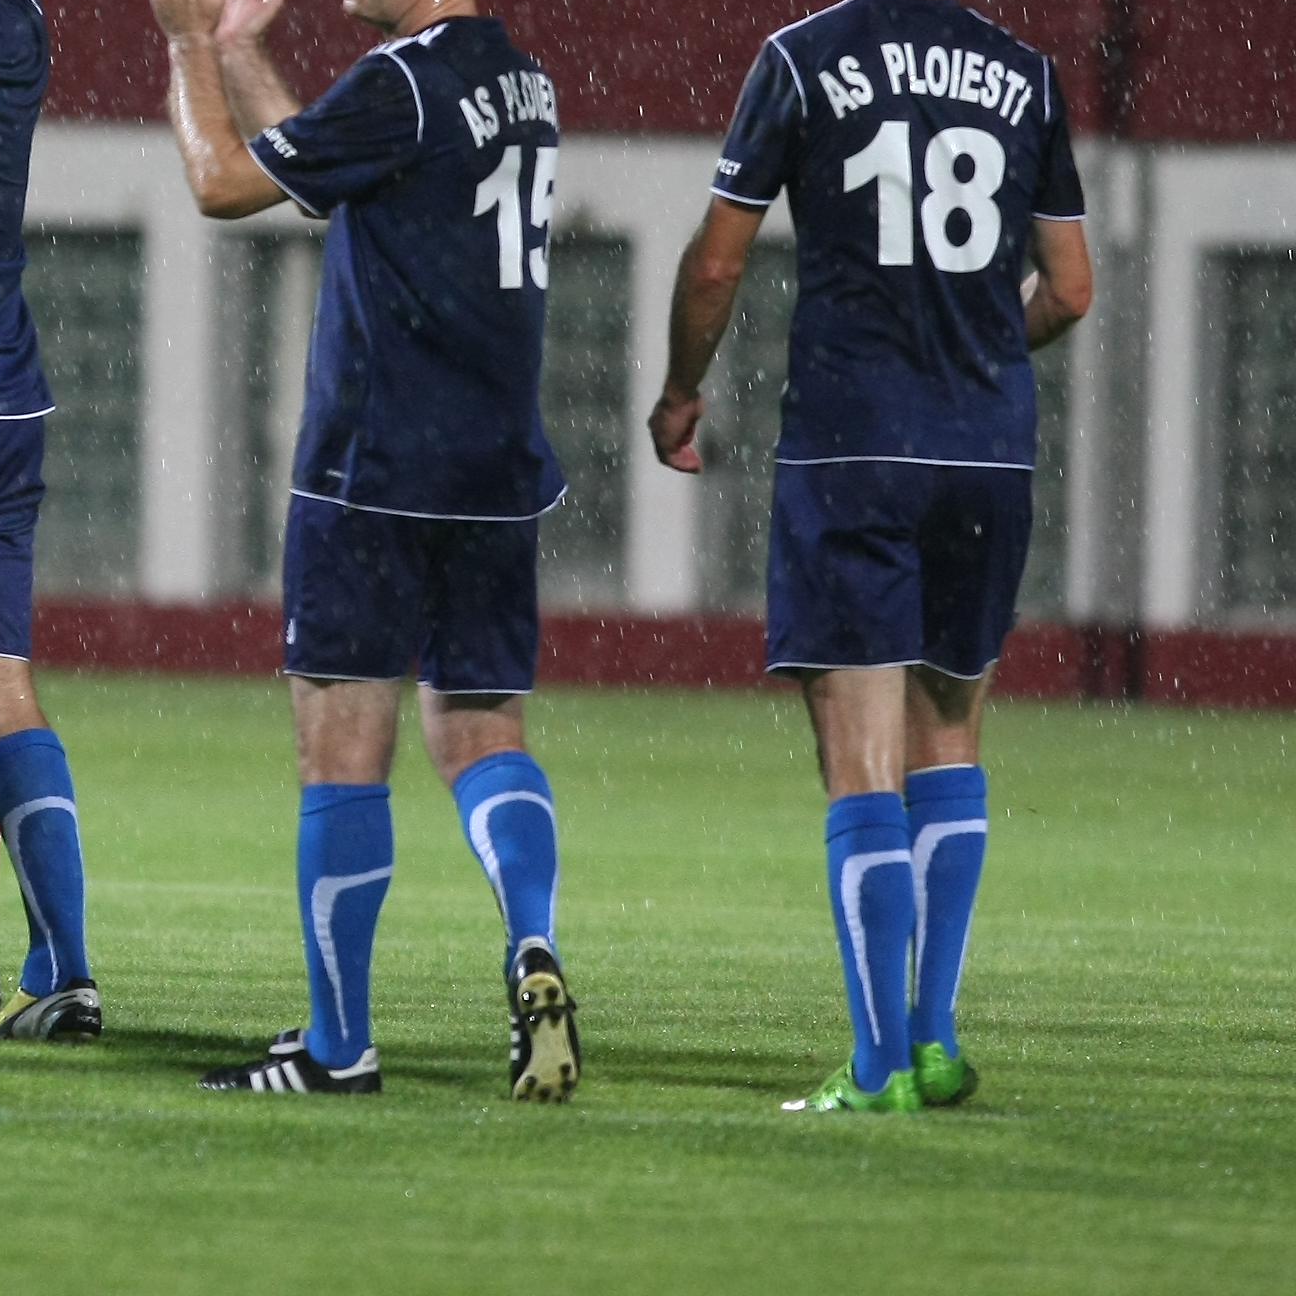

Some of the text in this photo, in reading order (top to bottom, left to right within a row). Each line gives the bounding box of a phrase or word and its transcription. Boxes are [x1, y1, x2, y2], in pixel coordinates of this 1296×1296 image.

[459, 86, 501, 150] AS
[818, 41, 1034, 127] AS PLOIESTI
[472, 144, 559, 291] 15
[843, 120, 1007, 274] 18
